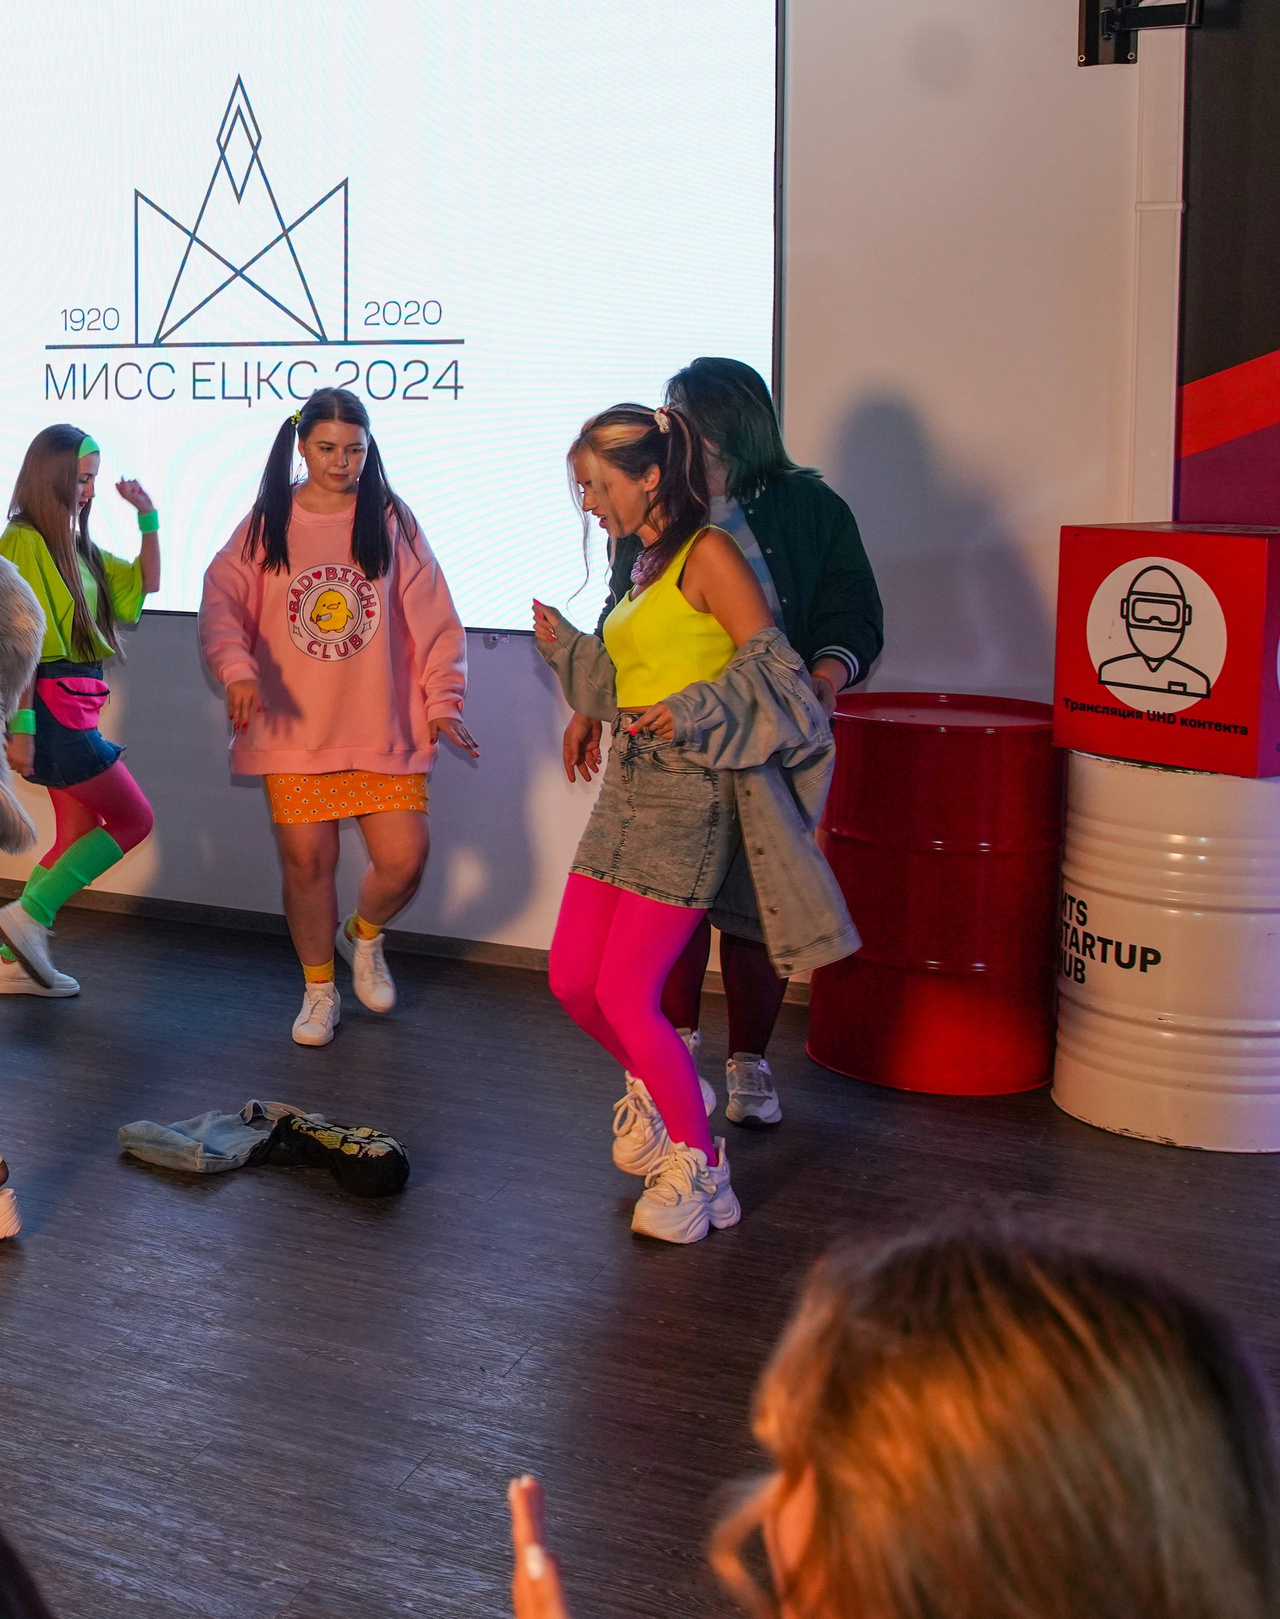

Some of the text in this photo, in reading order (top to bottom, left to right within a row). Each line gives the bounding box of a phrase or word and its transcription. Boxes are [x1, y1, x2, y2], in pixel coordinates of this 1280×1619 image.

[60, 307, 120, 332] 1920
[364, 300, 443, 326] 2020
[45, 359, 464, 408] МИСС ЕЦКС 2024
[289, 566, 377, 614] BAD BITCH
[306, 634, 364, 659] CLUB
[1062, 697, 1249, 736] Трансляция UHD контента
[1062, 920, 1162, 974] TARTUP
[1062, 949, 1086, 985] UB
